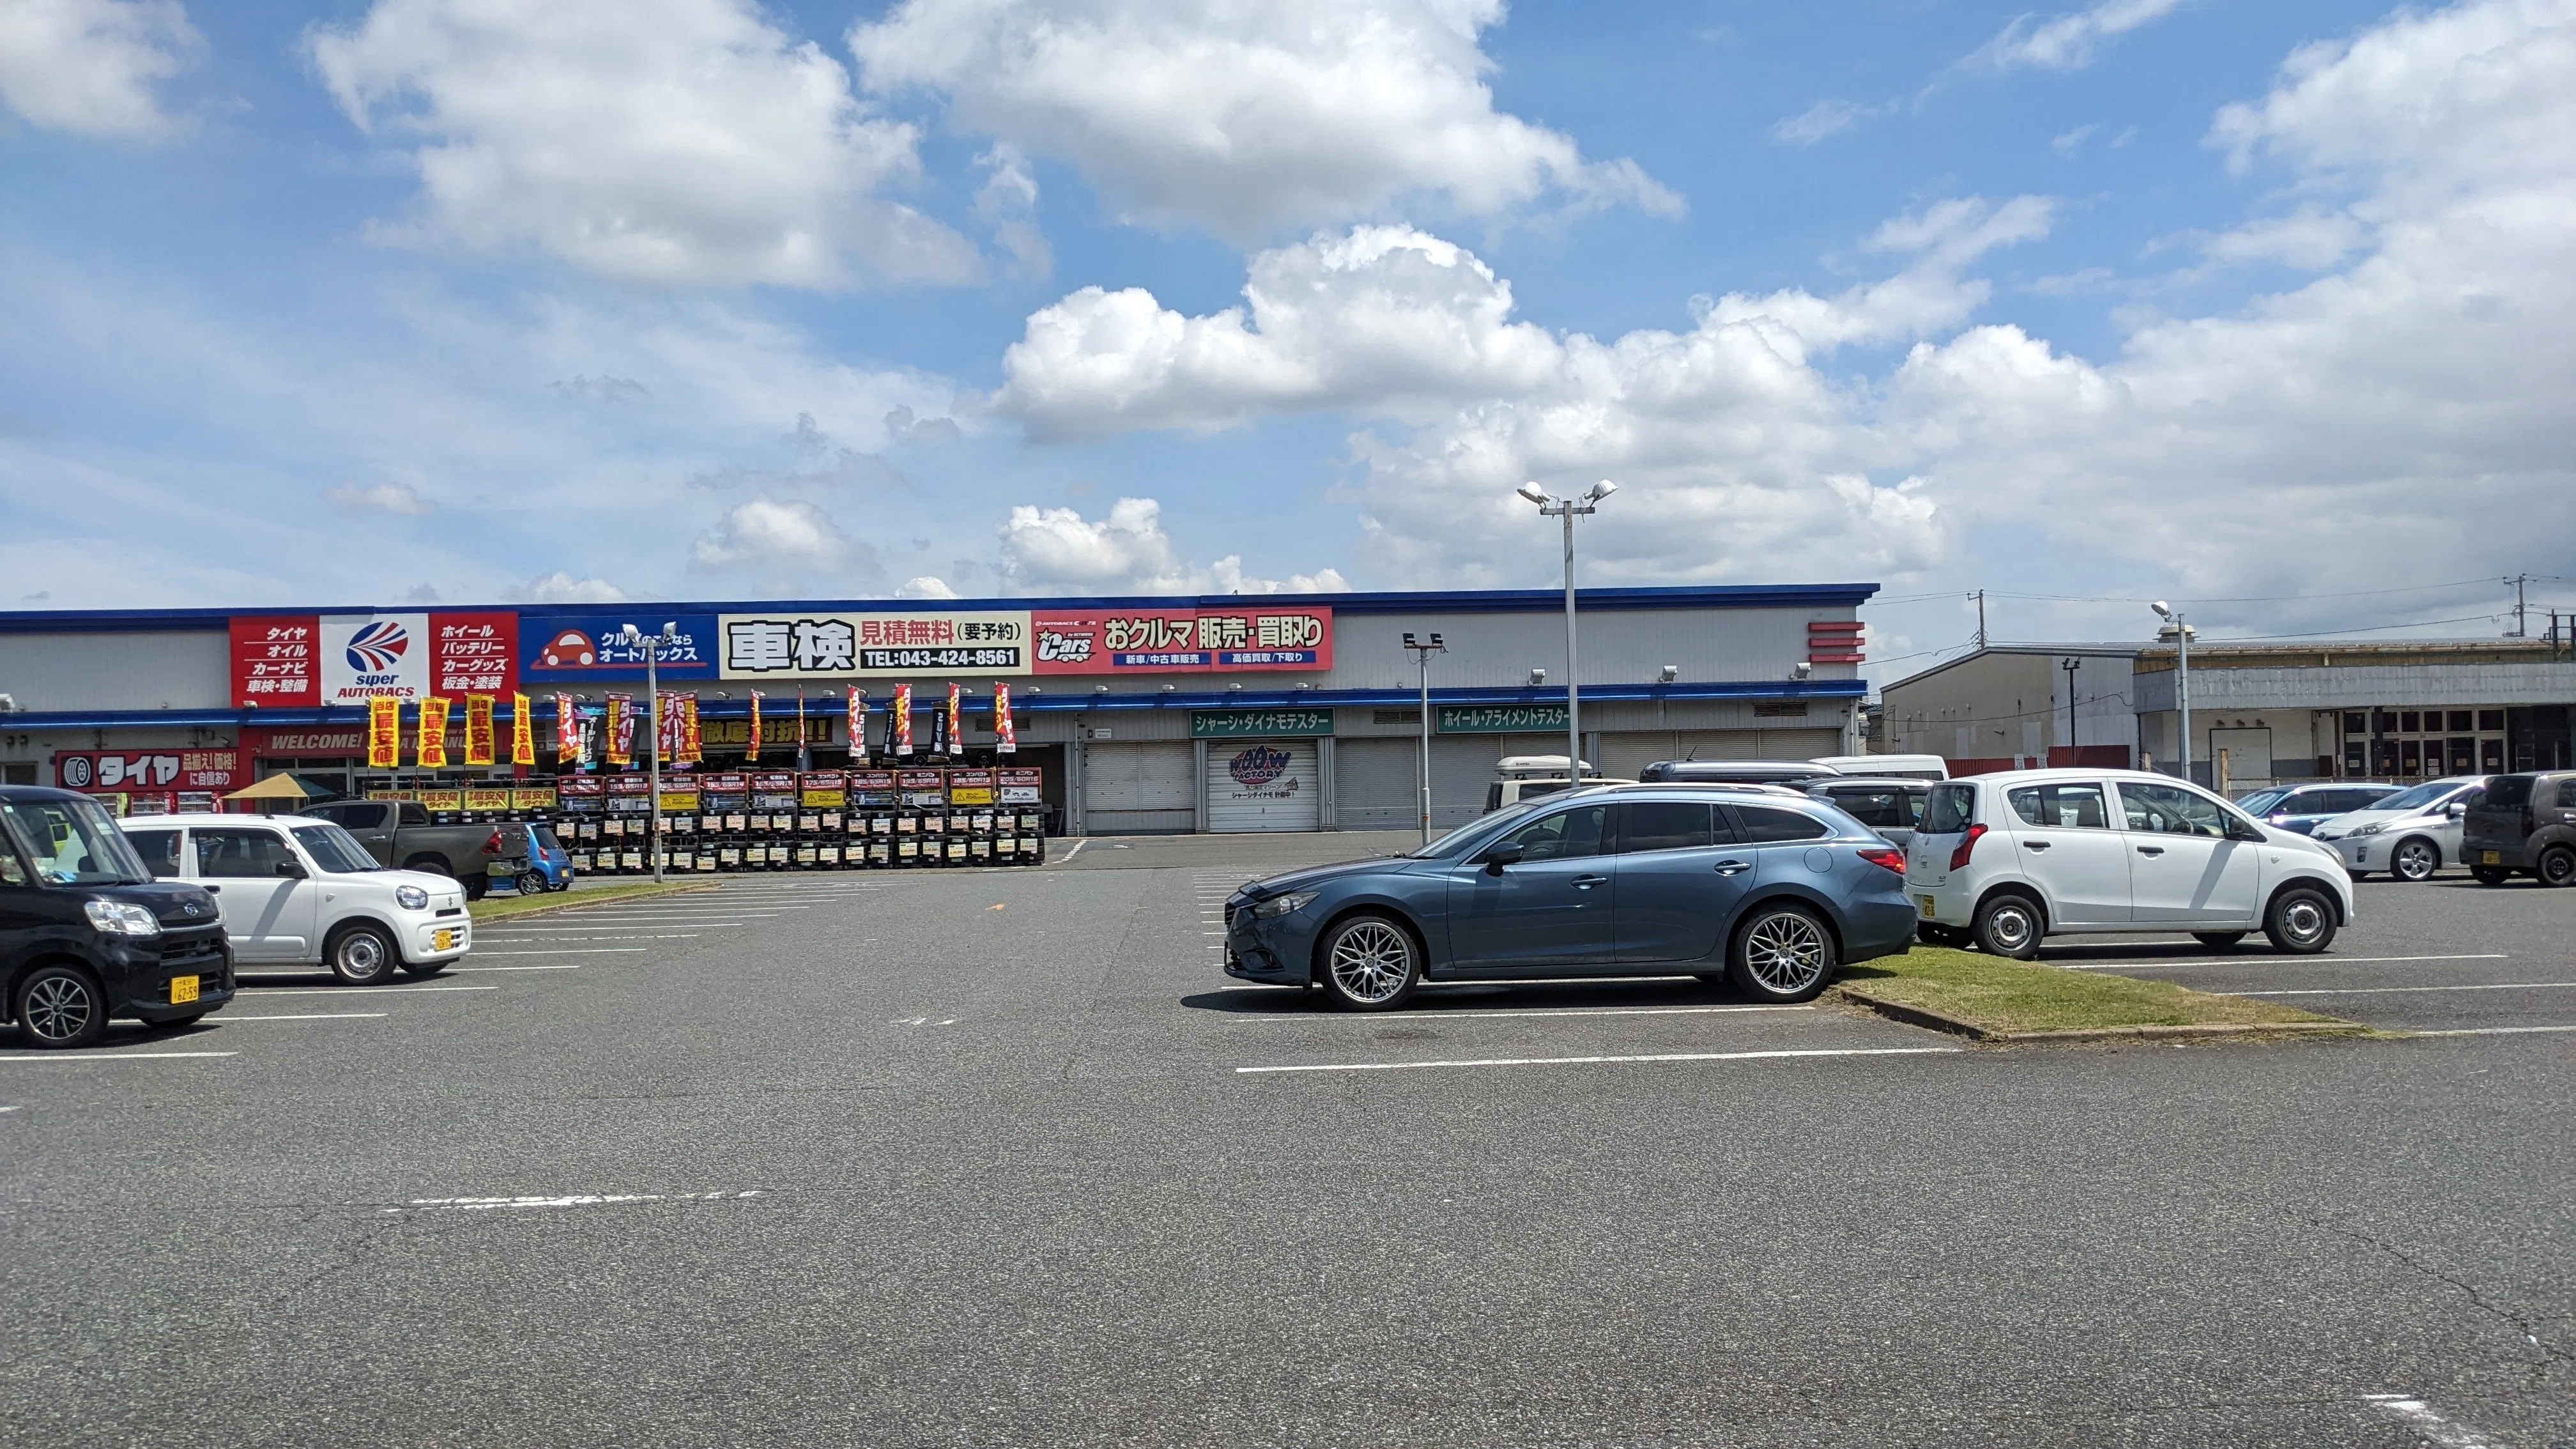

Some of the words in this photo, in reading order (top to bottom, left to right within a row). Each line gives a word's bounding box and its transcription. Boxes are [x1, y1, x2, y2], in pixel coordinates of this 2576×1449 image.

[267, 627, 307, 641] タイヤ
[441, 625, 494, 638] ホイール
[859, 619, 954, 646] 見積無料
[957, 622, 1021, 641] (要予約)
[1105, 617, 1195, 650] おクルマ
[1198, 615, 1324, 648] 販売・買取り
[601, 632, 692, 647] クルのこなら
[728, 619, 855, 671] 車検
[1037, 632, 1092, 661] Cars
[267, 645, 308, 657] オイル
[441, 642, 505, 655] バッテリー
[441, 658, 509, 671] カーグッズ
[865, 649, 1015, 667] TEL:043-424-8561
[1126, 654, 1199, 664] 新車/中古車販売
[1232, 653, 1303, 663] 高価買取/下取り
[252, 662, 307, 675] カーナビ
[247, 679, 308, 693] 車検・整備
[441, 676, 502, 690] 板金・塗装
[337, 687, 415, 698] AUTOBACS
[661, 699, 673, 749] タイヤ
[1196, 712, 1329, 732] シャーシ・ダイナモテスター
[1445, 709, 1570, 726] ホイール・アライメントテスター
[564, 703, 577, 747] タイヤ
[618, 702, 630, 752] タイヤ
[272, 733, 363, 749] WELCOME!
[98, 756, 179, 786] タイヤ
[1234, 770, 1283, 781] FACTORY
[190, 772, 230, 786] に自信あり
